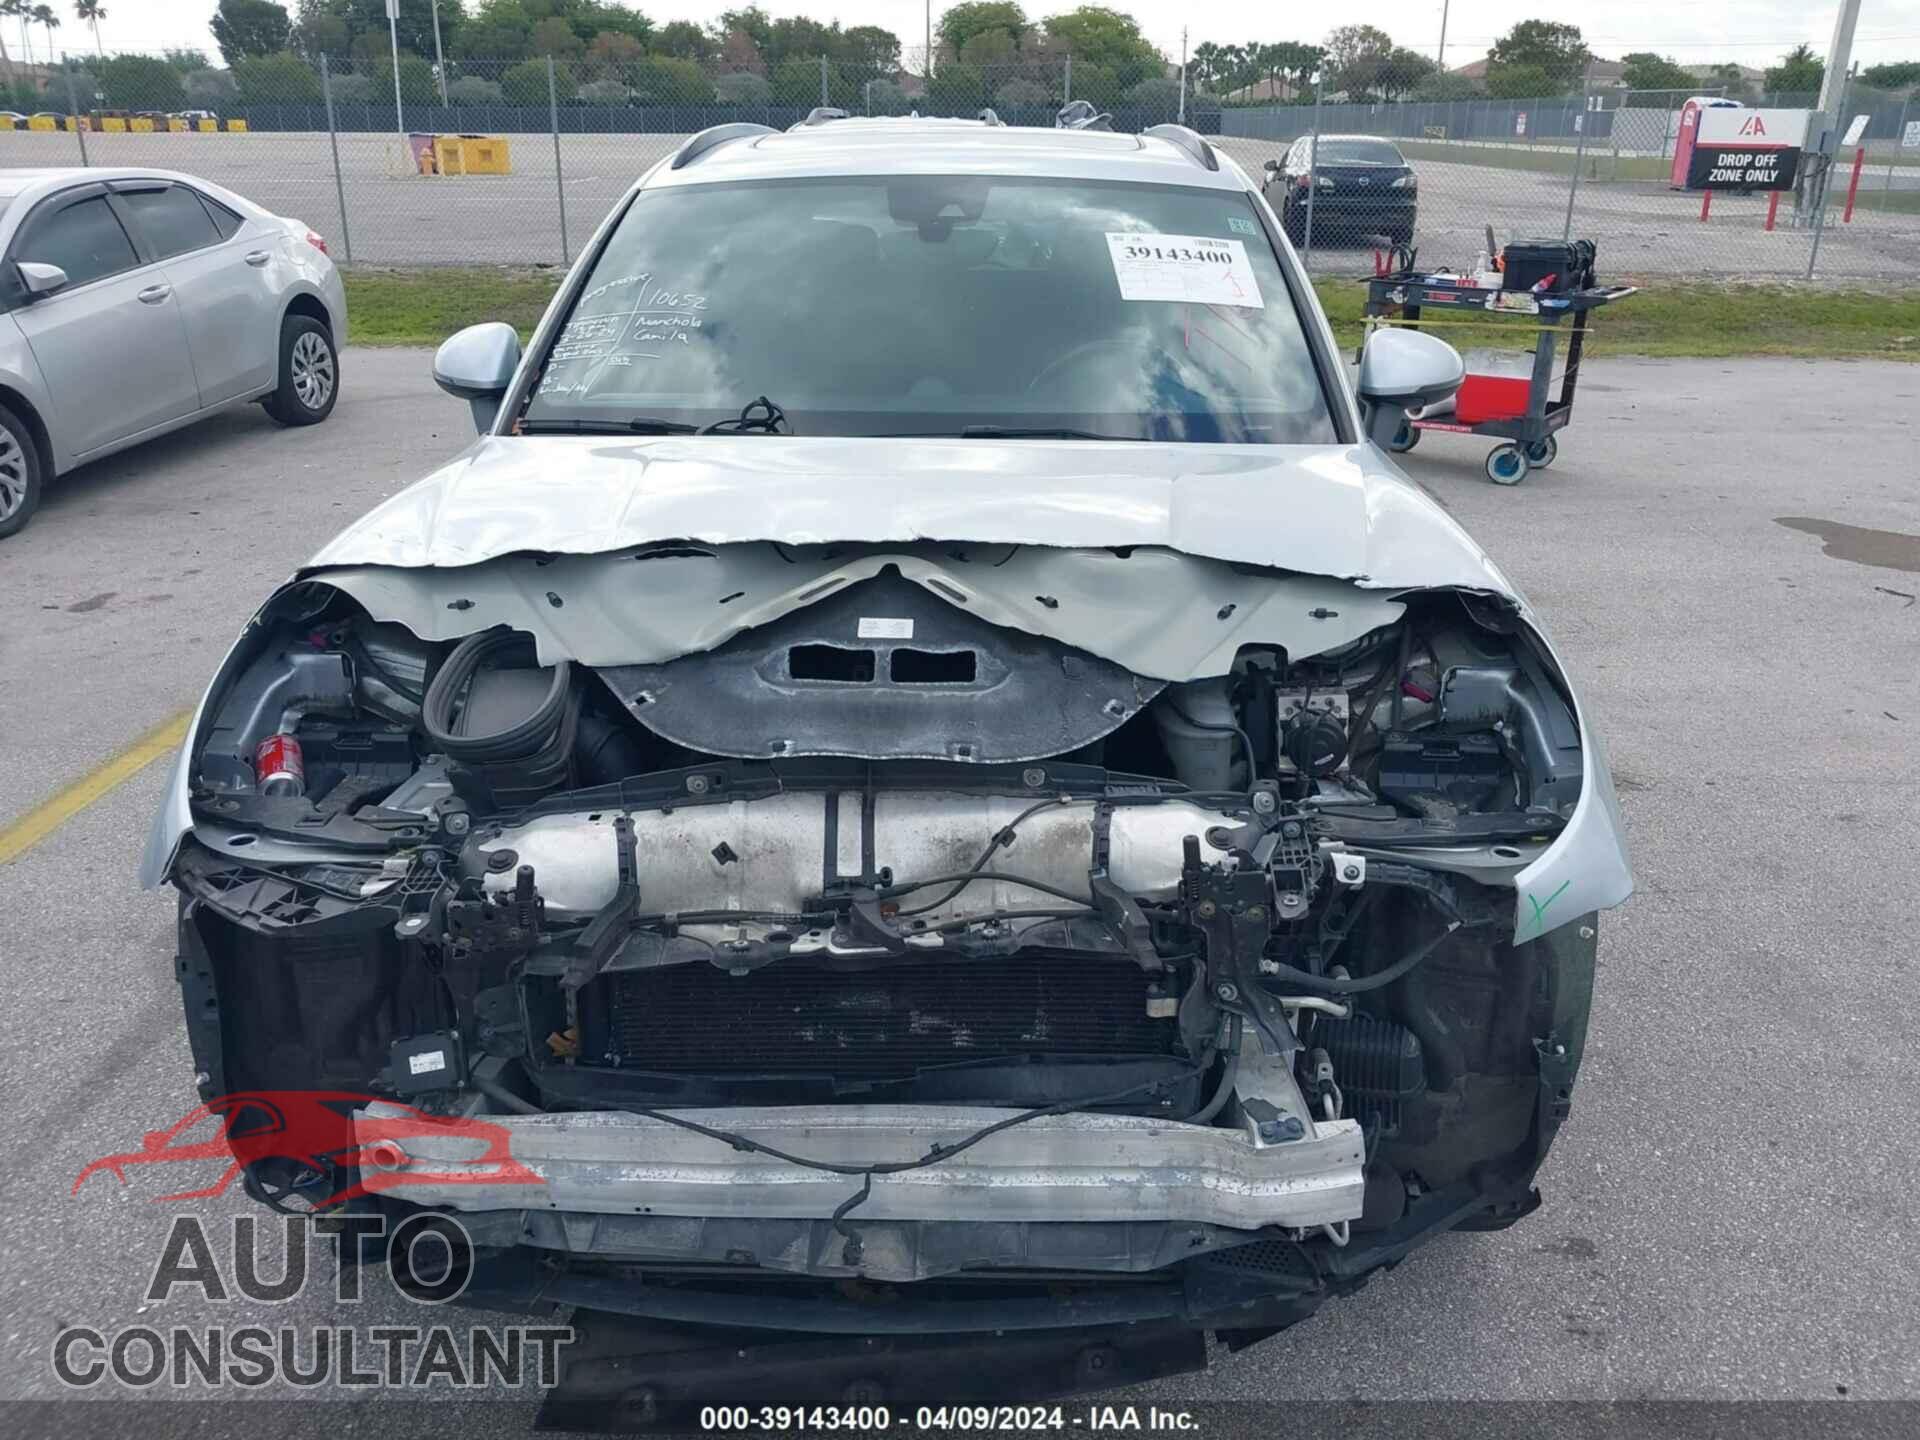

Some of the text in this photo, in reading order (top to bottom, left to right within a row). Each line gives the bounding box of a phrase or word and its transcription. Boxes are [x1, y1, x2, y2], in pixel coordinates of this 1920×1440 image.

[1717, 153, 1779, 167] DROP OFF
[1708, 168, 1779, 183] ZONE ONLY
[1124, 245, 1233, 265] 39143400
[648, 288, 709, 310] 10652
